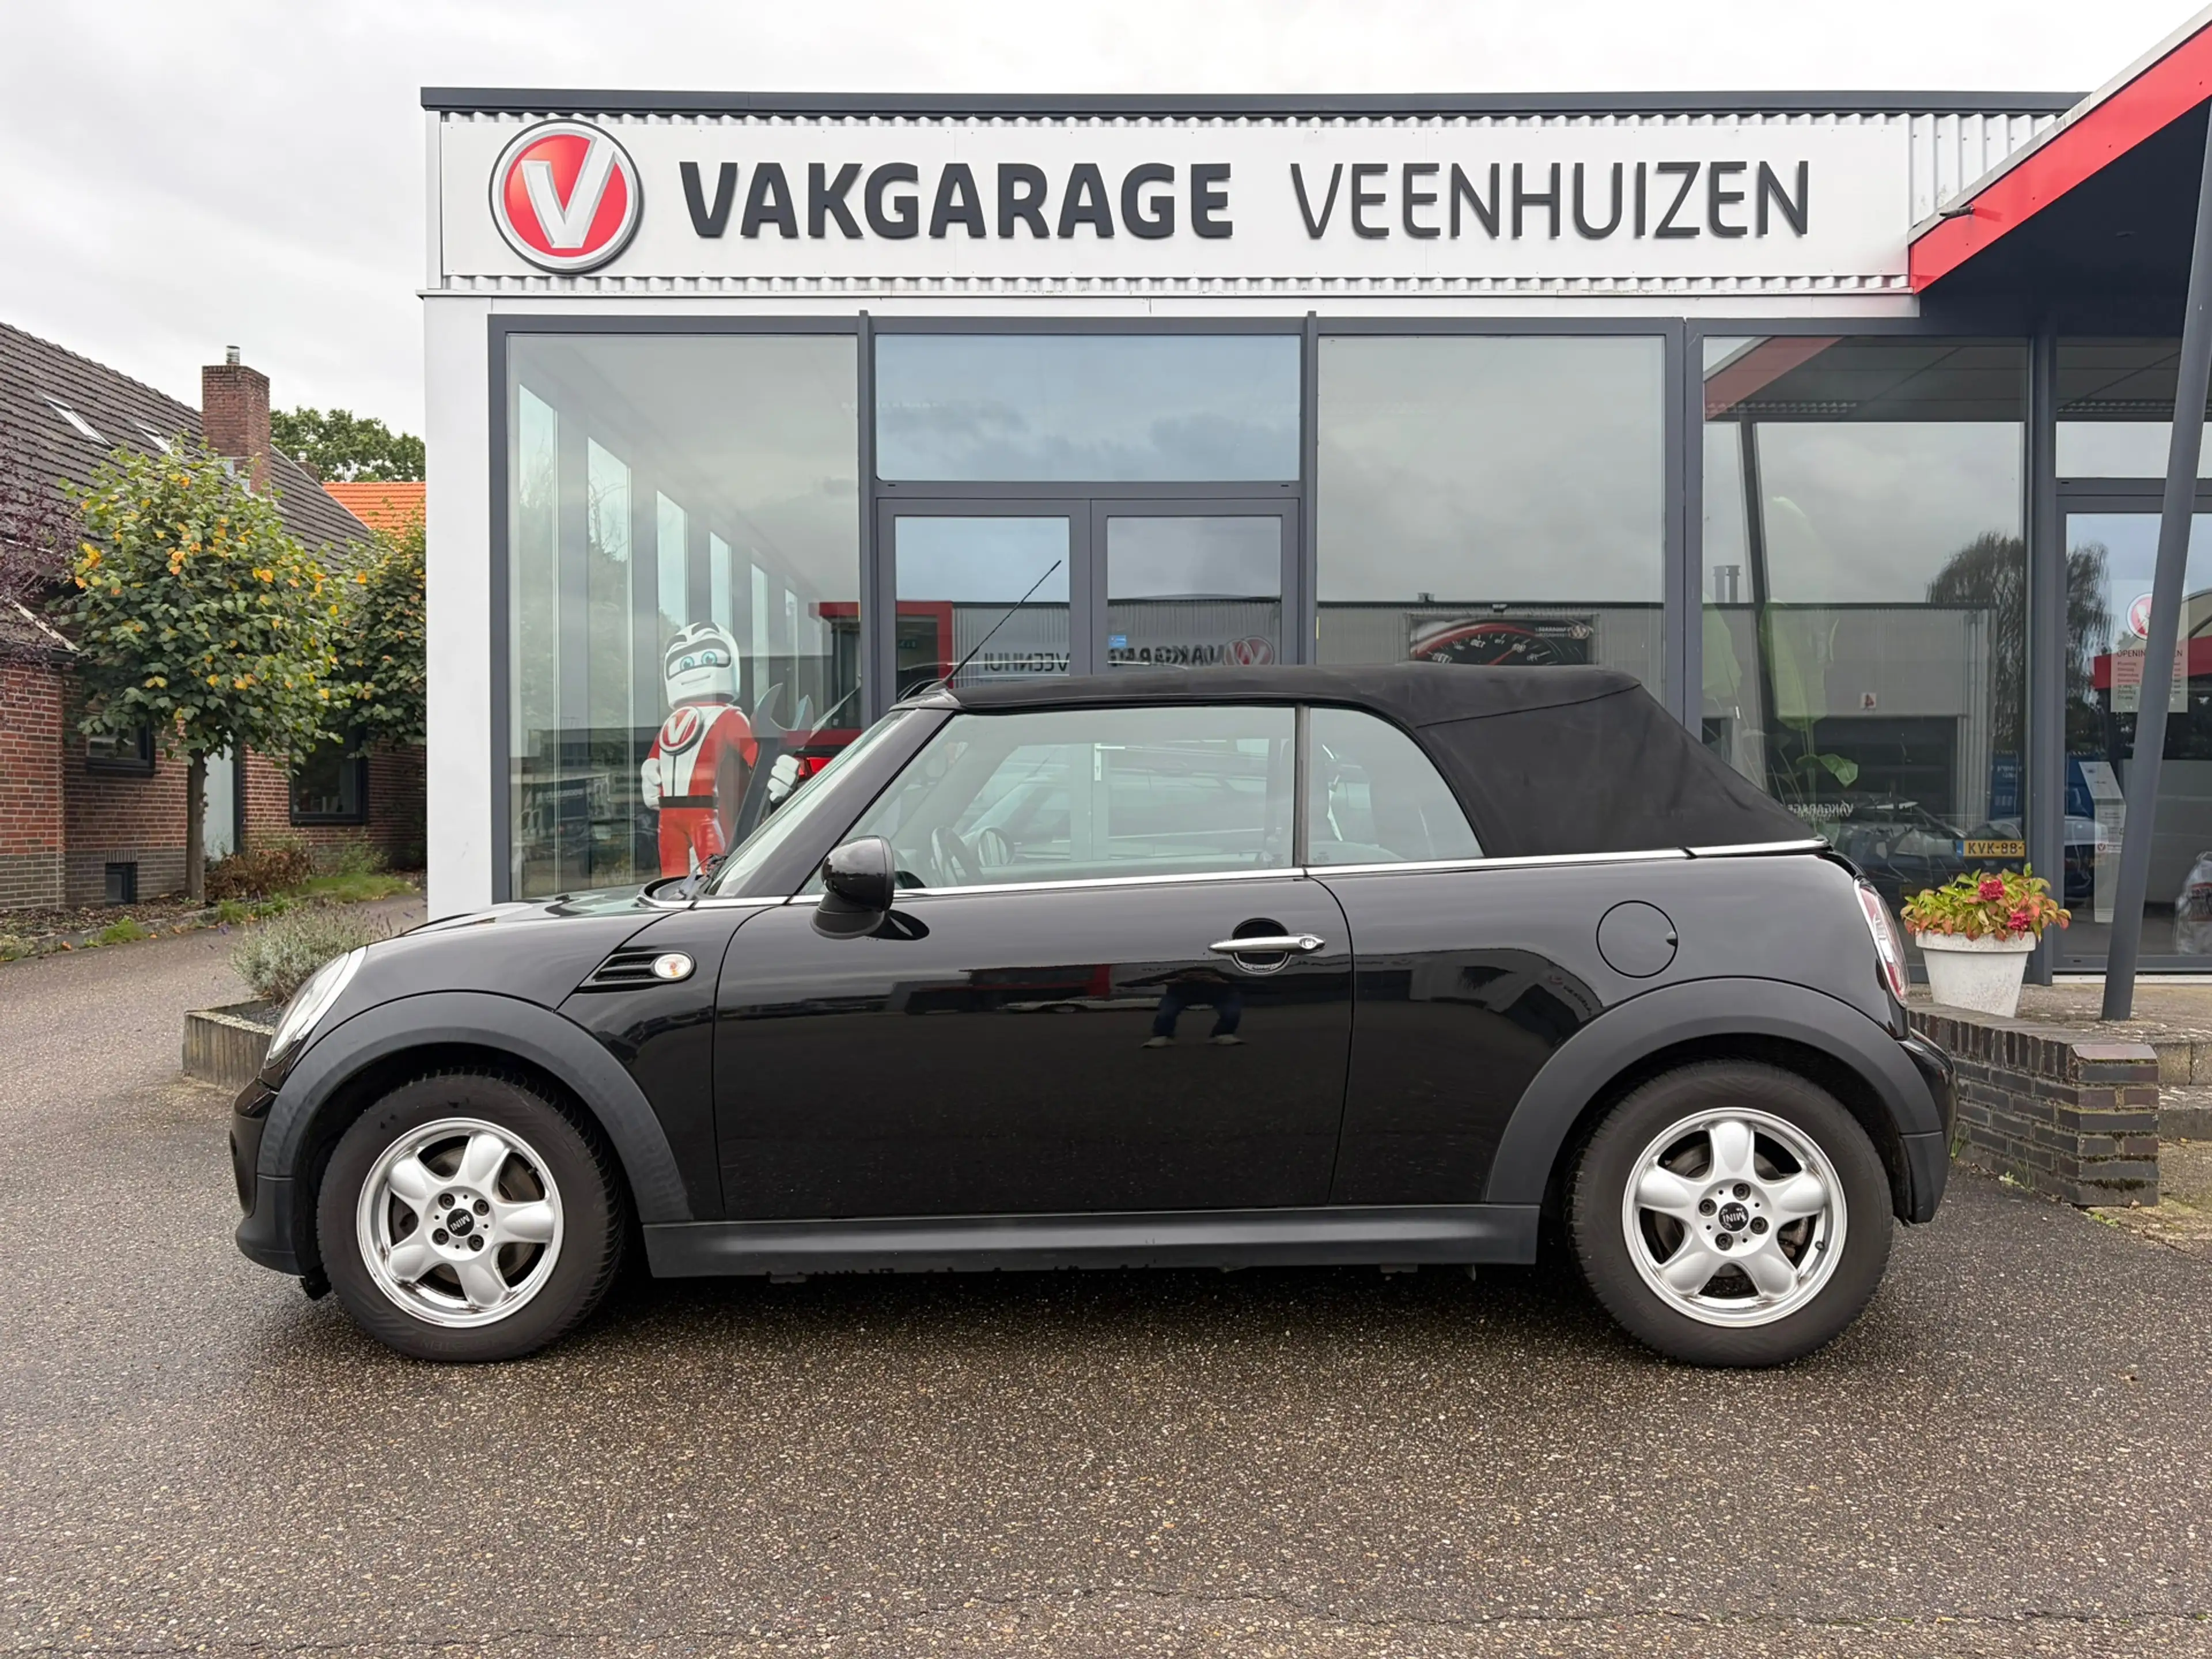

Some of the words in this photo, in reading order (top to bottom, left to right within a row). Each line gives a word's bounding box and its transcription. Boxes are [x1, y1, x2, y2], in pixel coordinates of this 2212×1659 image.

[680, 162, 1233, 240] VAKGARAGE
[1290, 161, 1808, 240] VEENHUIZEN
[1968, 842, 2025, 854] KVK-88-
[450, 1214, 471, 1231] MINI
[1723, 1212, 1747, 1222] MINI
